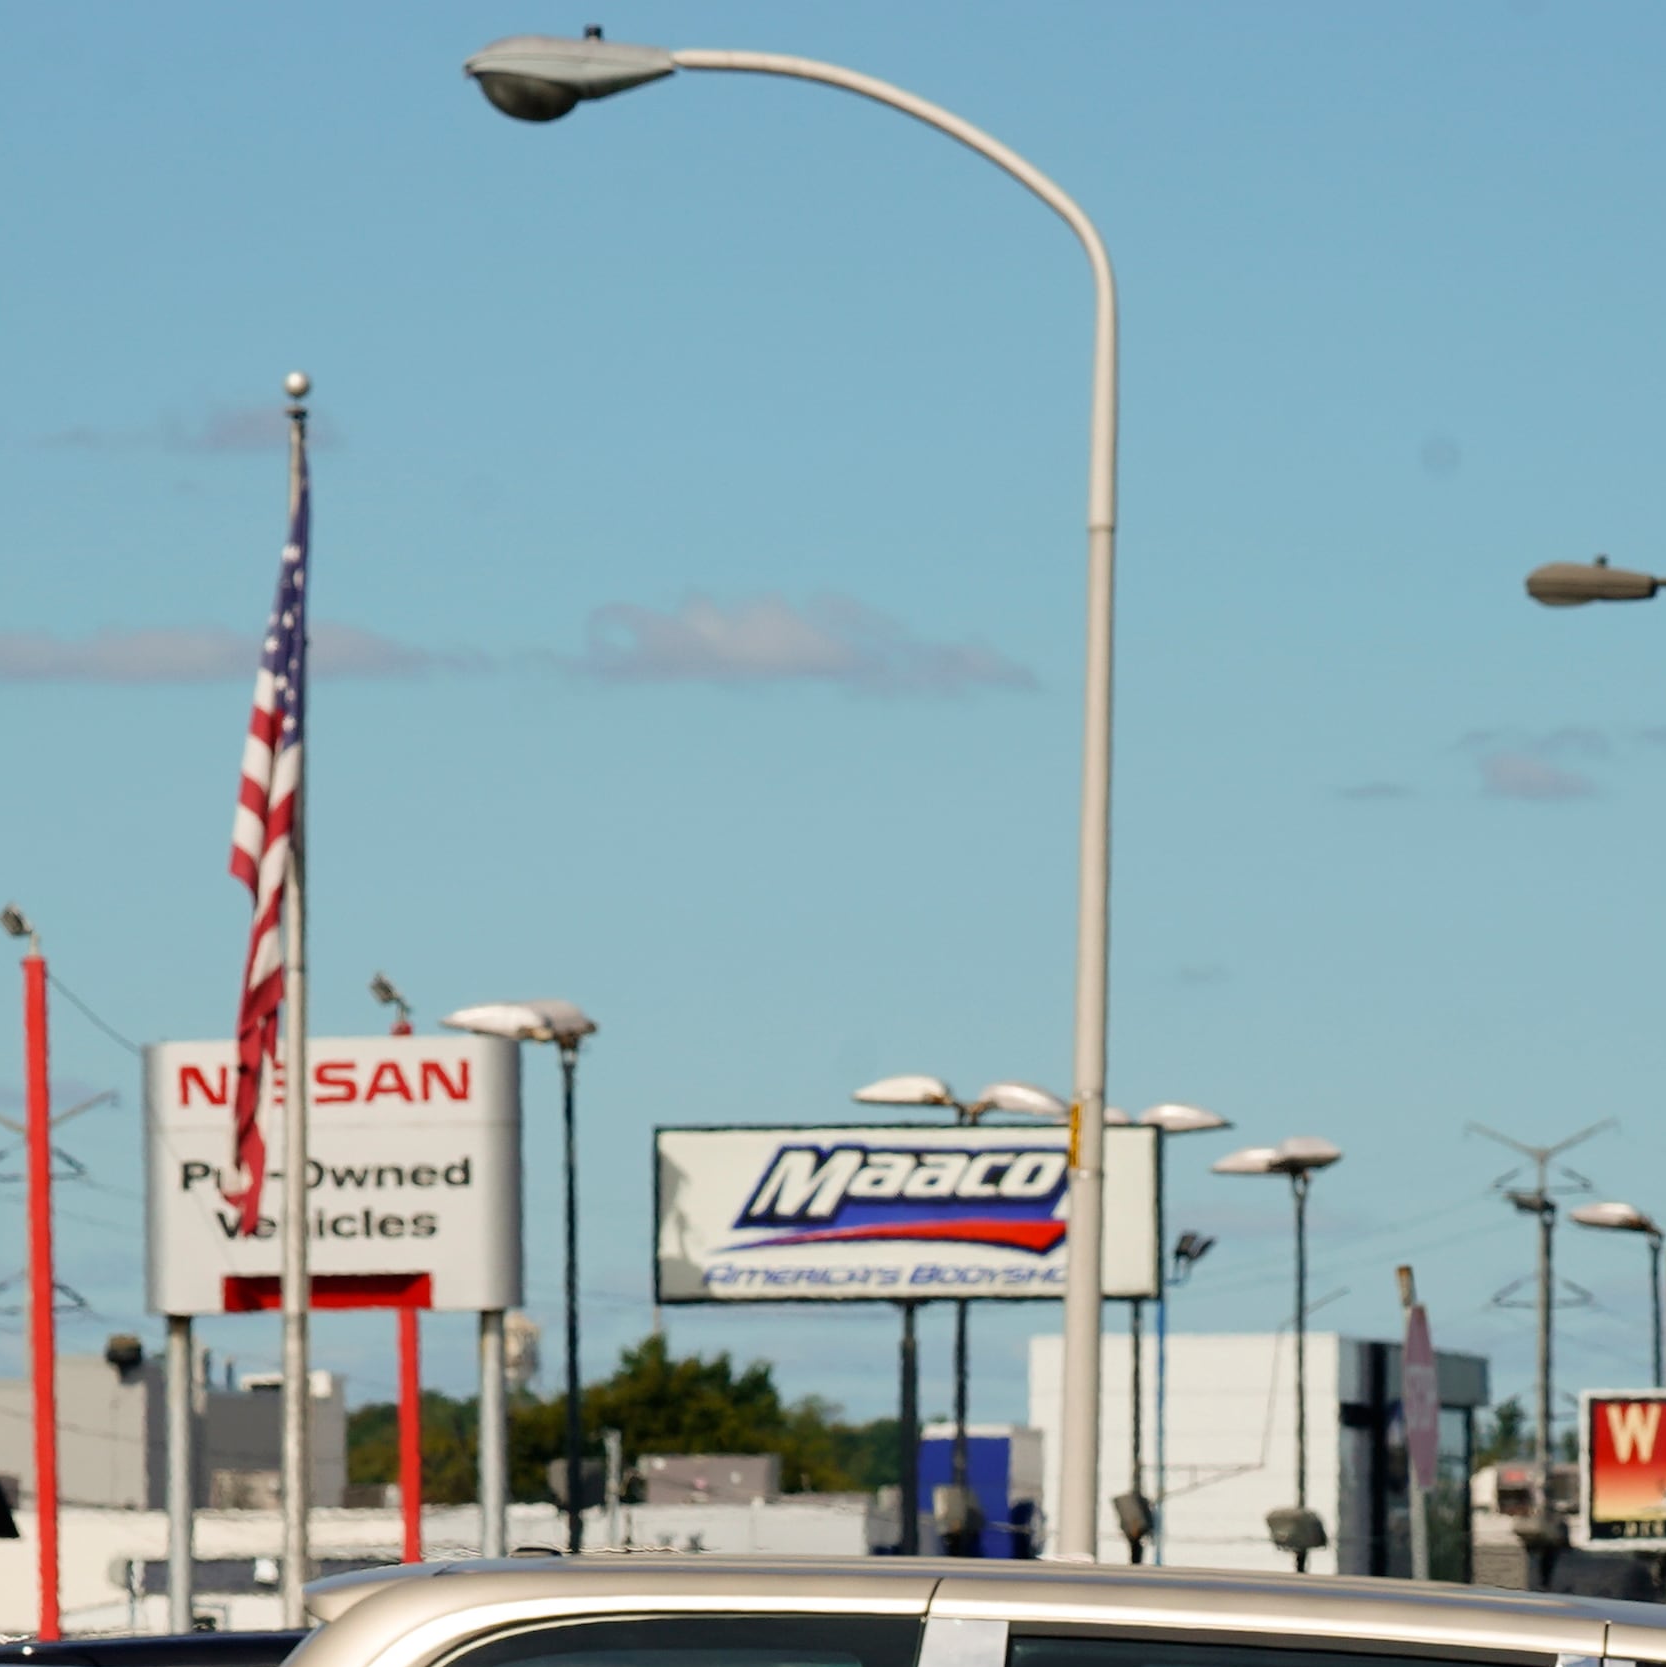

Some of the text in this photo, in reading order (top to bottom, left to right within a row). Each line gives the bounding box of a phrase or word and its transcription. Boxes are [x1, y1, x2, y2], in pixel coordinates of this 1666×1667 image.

[179, 1060, 471, 1106] NSAN
[748, 1147, 1066, 1219] Maaco
[217, 1209, 439, 1239] Veicles
[909, 1262, 1068, 1287] BODYSHO
